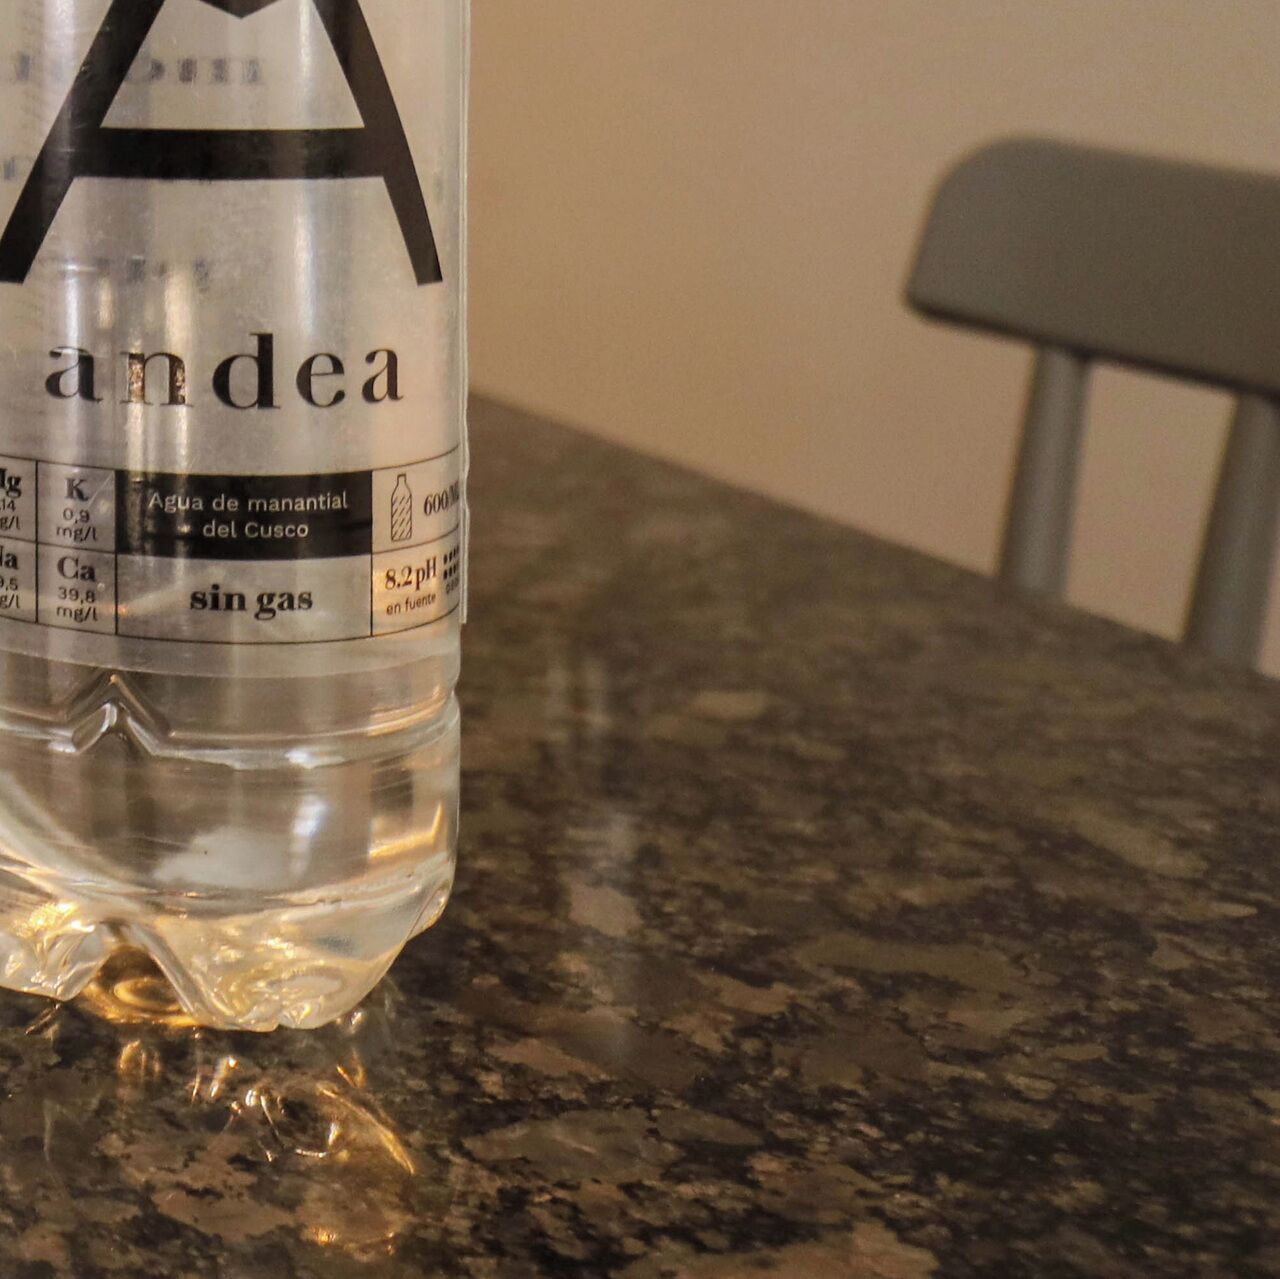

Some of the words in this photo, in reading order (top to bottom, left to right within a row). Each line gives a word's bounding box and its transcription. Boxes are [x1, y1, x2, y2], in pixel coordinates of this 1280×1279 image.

[45, 332, 404, 410] andea
[65, 478, 89, 502] K
[148, 493, 203, 513] Agua
[212, 494, 239, 511] de
[248, 491, 348, 511] manantial
[63, 507, 90, 524] 0,9
[56, 526, 97, 543] mg/l
[202, 520, 237, 537] del
[244, 523, 309, 538] Cusco
[57, 556, 96, 582] Ca
[57, 587, 96, 604] 39,8
[190, 584, 246, 611] sin
[254, 591, 313, 620] gas
[386, 603, 401, 615] en
[404, 592, 437, 612] fuente
[56, 605, 98, 622] mg/l
